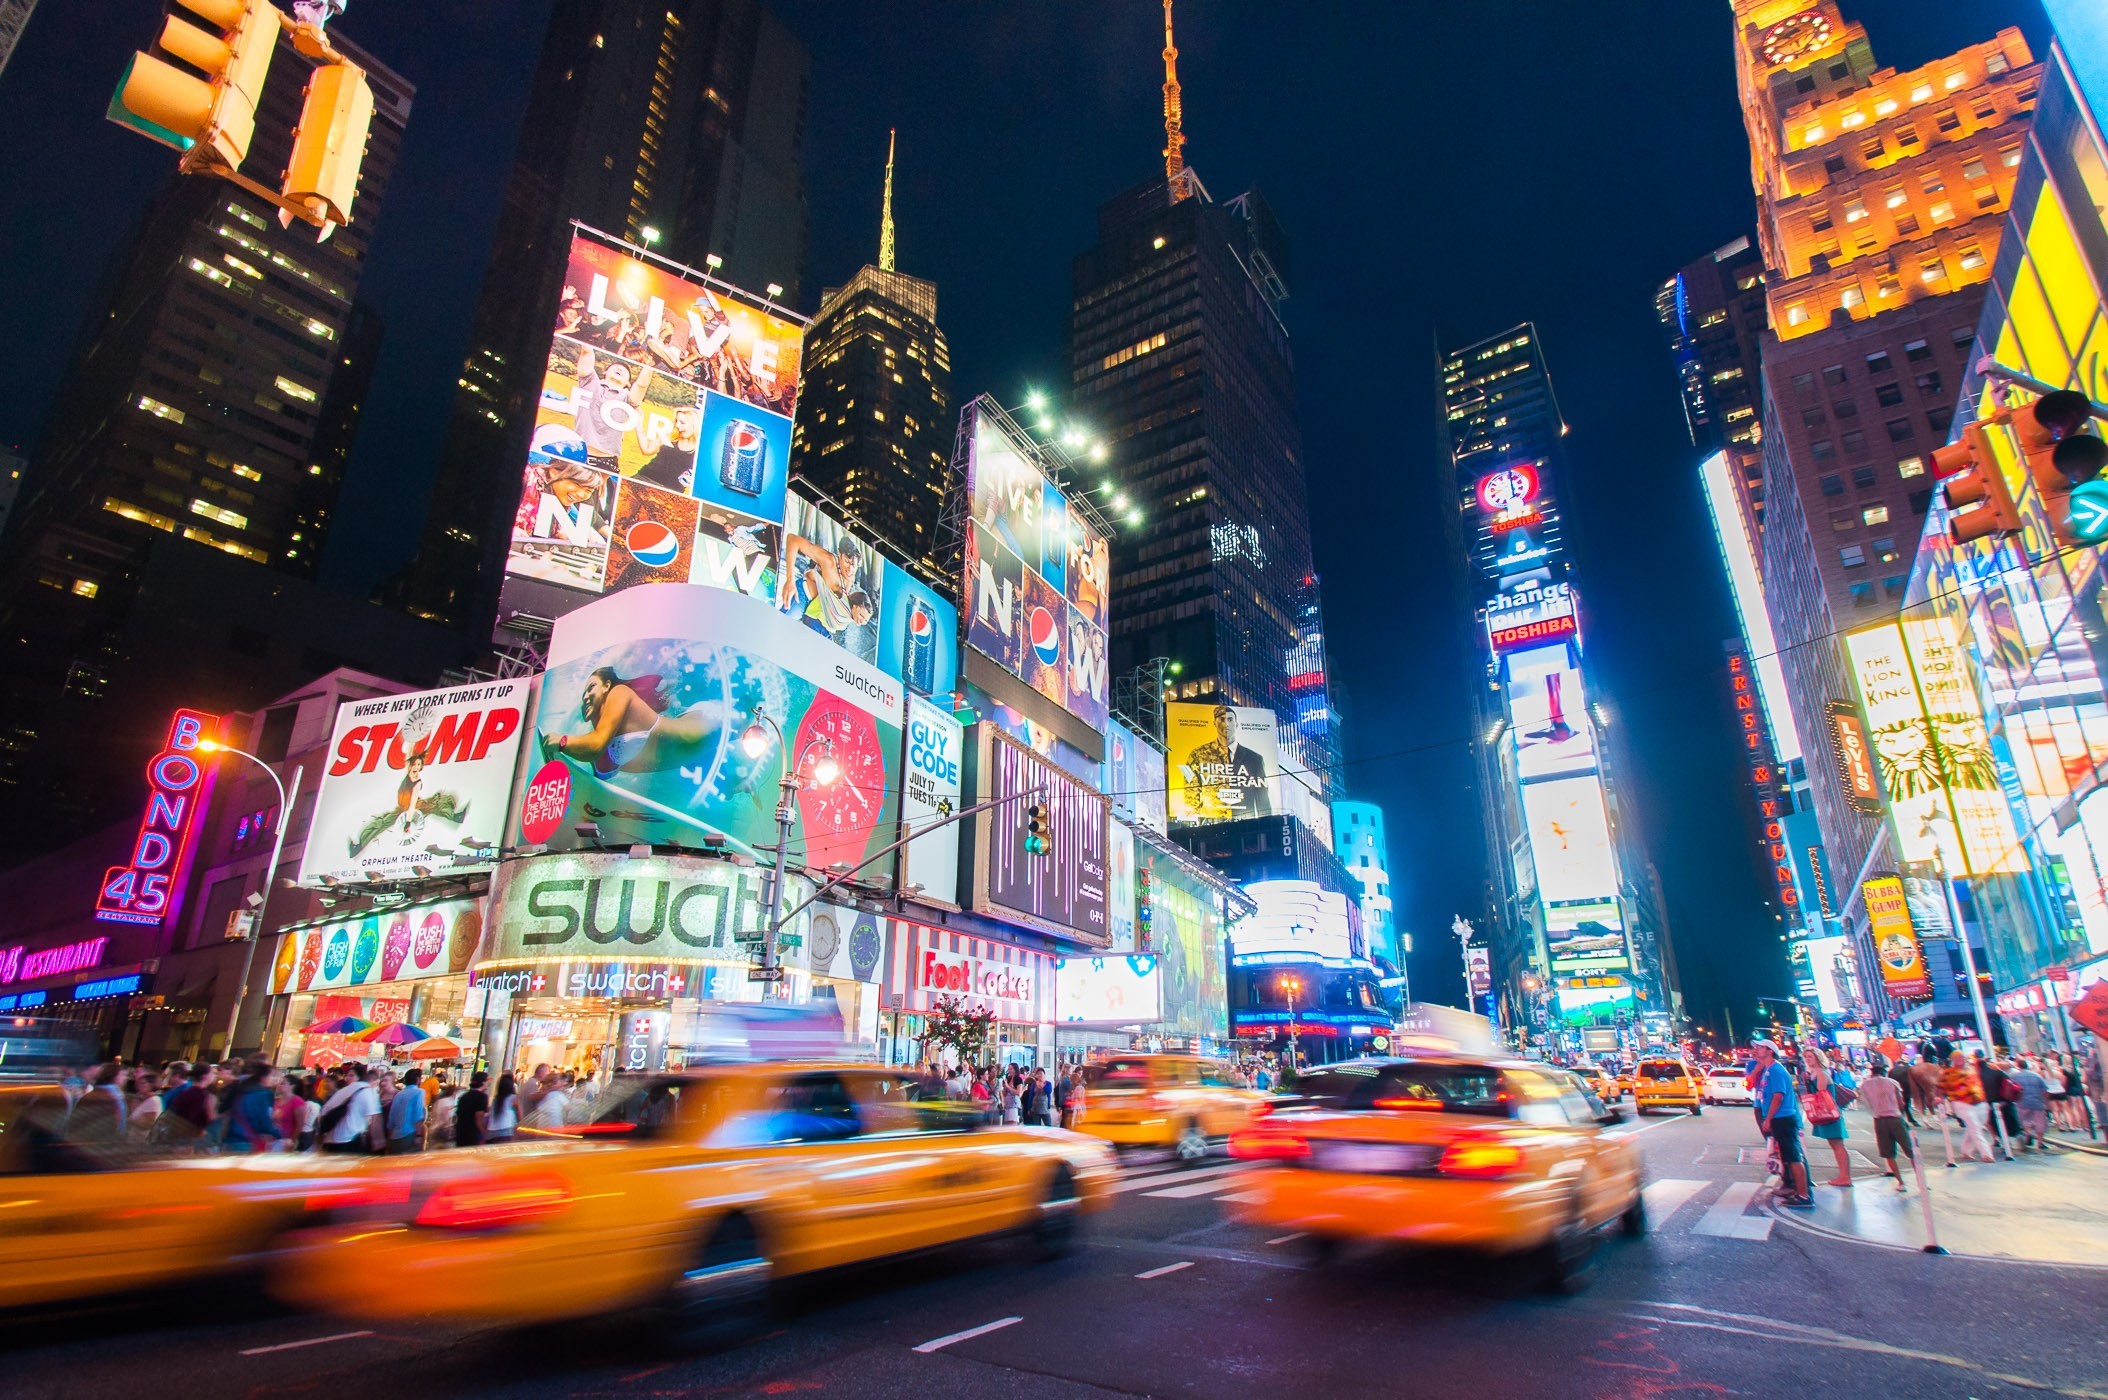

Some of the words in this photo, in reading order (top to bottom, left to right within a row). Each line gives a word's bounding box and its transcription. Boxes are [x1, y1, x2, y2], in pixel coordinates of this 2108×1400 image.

[589, 273, 779, 382] LIVE
[570, 386, 676, 448] FOR
[983, 467, 1034, 527] LIVE
[1491, 512, 1543, 532] TOSHIBA
[1070, 546, 1106, 598] FOR
[1487, 582, 1570, 612] change
[1493, 616, 1574, 644] TOSHIBA
[1864, 656, 1892, 669] THE
[835, 665, 885, 703] swatch
[1864, 669, 1902, 687] LION
[354, 701, 390, 717] WHERE
[391, 698, 416, 712] NEW
[418, 693, 447, 708] YORK
[448, 688, 483, 704] TURNS
[484, 687, 495, 699] IT
[497, 685, 513, 697] UP
[1866, 686, 1912, 707] KING
[328, 707, 520, 777] STOMP
[911, 720, 947, 755] GUY
[911, 743, 957, 786] CODE
[1200, 763, 1234, 776] HIRE
[1237, 764, 1249, 777] A
[135, 716, 200, 868] BOND
[527, 777, 568, 804] PUSH
[909, 771, 926, 789] JULY
[928, 780, 935, 792] 17
[1200, 774, 1269, 788] VETERAN
[1729, 657, 1758, 748] ERNST
[1754, 767, 1769, 783] &
[1762, 802, 1797, 905] YOUNG
[527, 802, 539, 812] THE
[540, 796, 565, 810] BUTTON
[909, 785, 926, 804] TUES
[524, 810, 540, 826] OF
[541, 804, 564, 822] FUN
[1282, 815, 1291, 857] 1500
[362, 856, 398, 866] ORPHEUM
[401, 853, 433, 862] THEATRE
[105, 871, 169, 911] 45
[1865, 885, 1902, 899] BUBBA
[1871, 899, 1902, 914] GUMP
[97, 911, 161, 926] RESTAURANT
[418, 925, 443, 939] PUSH
[328, 941, 348, 954] PUSH
[415, 946, 425, 956] OF
[425, 943, 440, 954] FUN
[20, 937, 105, 981] RESTAURANT
[475, 970, 532, 992] swatch
[569, 970, 668, 991] swatch
[923, 951, 970, 993] Foot
[975, 960, 1032, 1001] Locker
[1574, 968, 1608, 976] SONY
